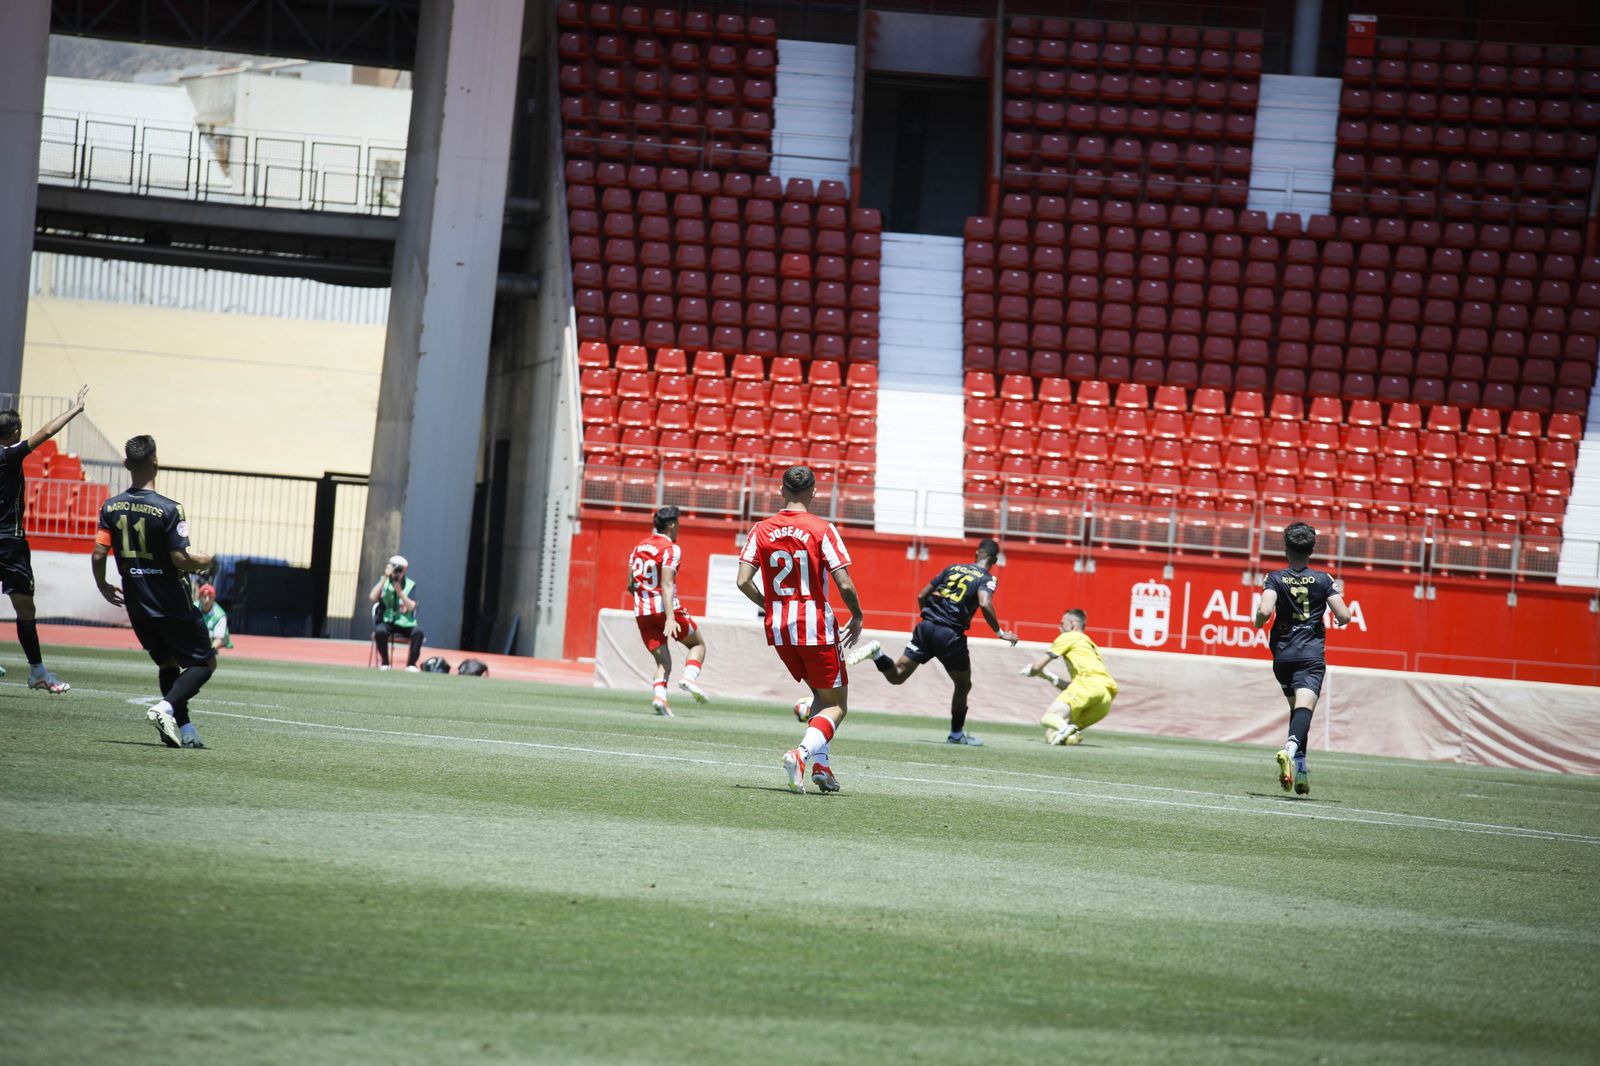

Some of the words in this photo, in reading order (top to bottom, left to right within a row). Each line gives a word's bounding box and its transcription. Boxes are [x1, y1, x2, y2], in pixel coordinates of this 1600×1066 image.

[107, 501, 130, 513] MARIO
[131, 503, 163, 517] MARTOS
[116, 514, 154, 560] 11
[768, 526, 811, 544] JOSEMA
[631, 557, 659, 592] 29
[769, 549, 811, 596] 21
[1200, 623, 1271, 649] CIUDA
